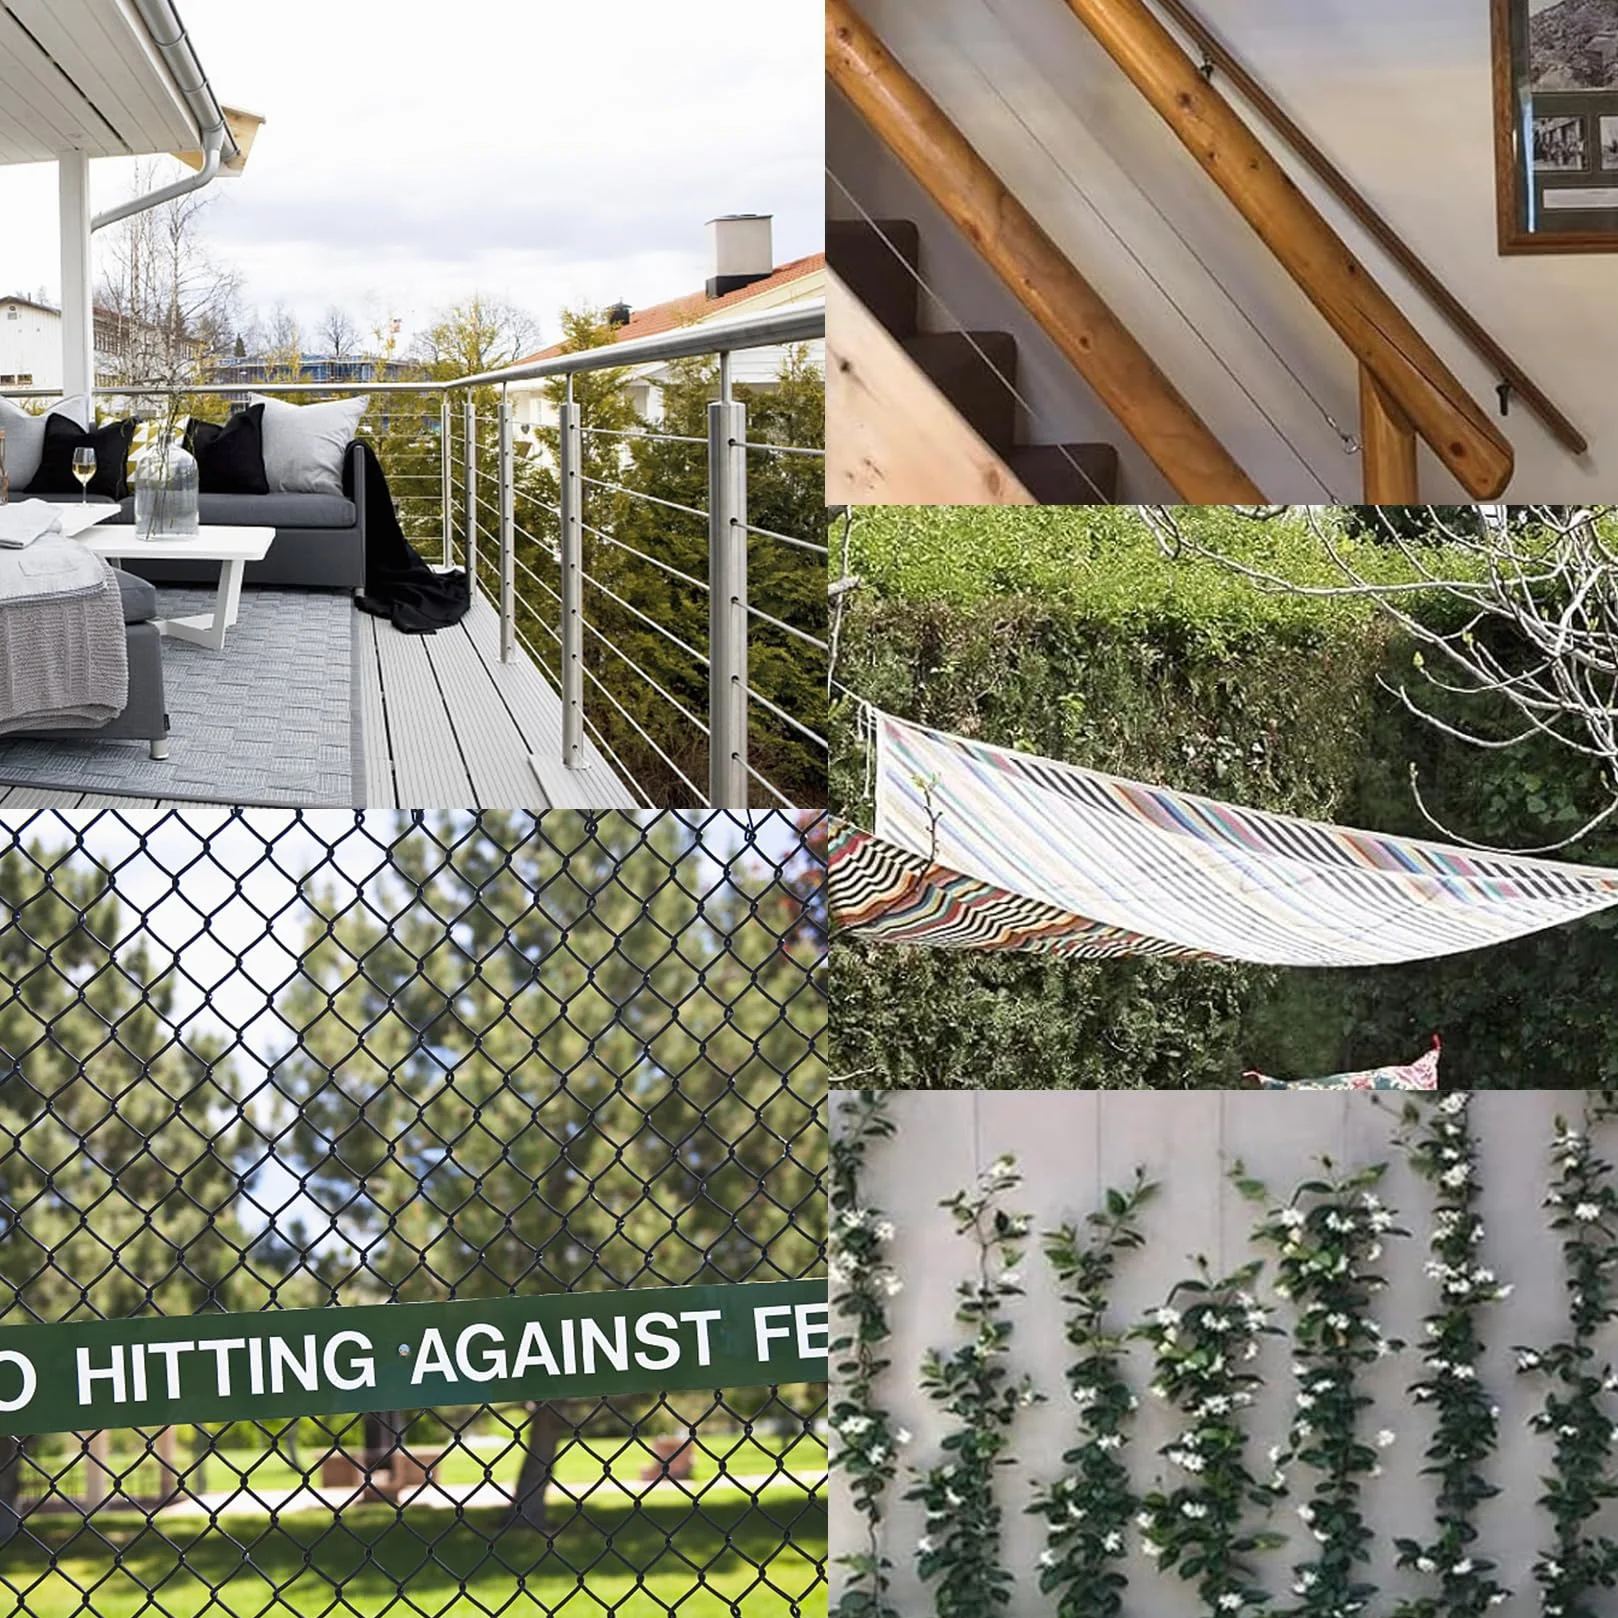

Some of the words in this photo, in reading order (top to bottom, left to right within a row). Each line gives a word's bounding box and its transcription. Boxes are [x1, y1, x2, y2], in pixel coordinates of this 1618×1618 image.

[0, 1350, 37, 1412] O
[76, 1330, 376, 1405] HITTING
[410, 1309, 722, 1385] AGAINST
[753, 1302, 828, 1363] FE
